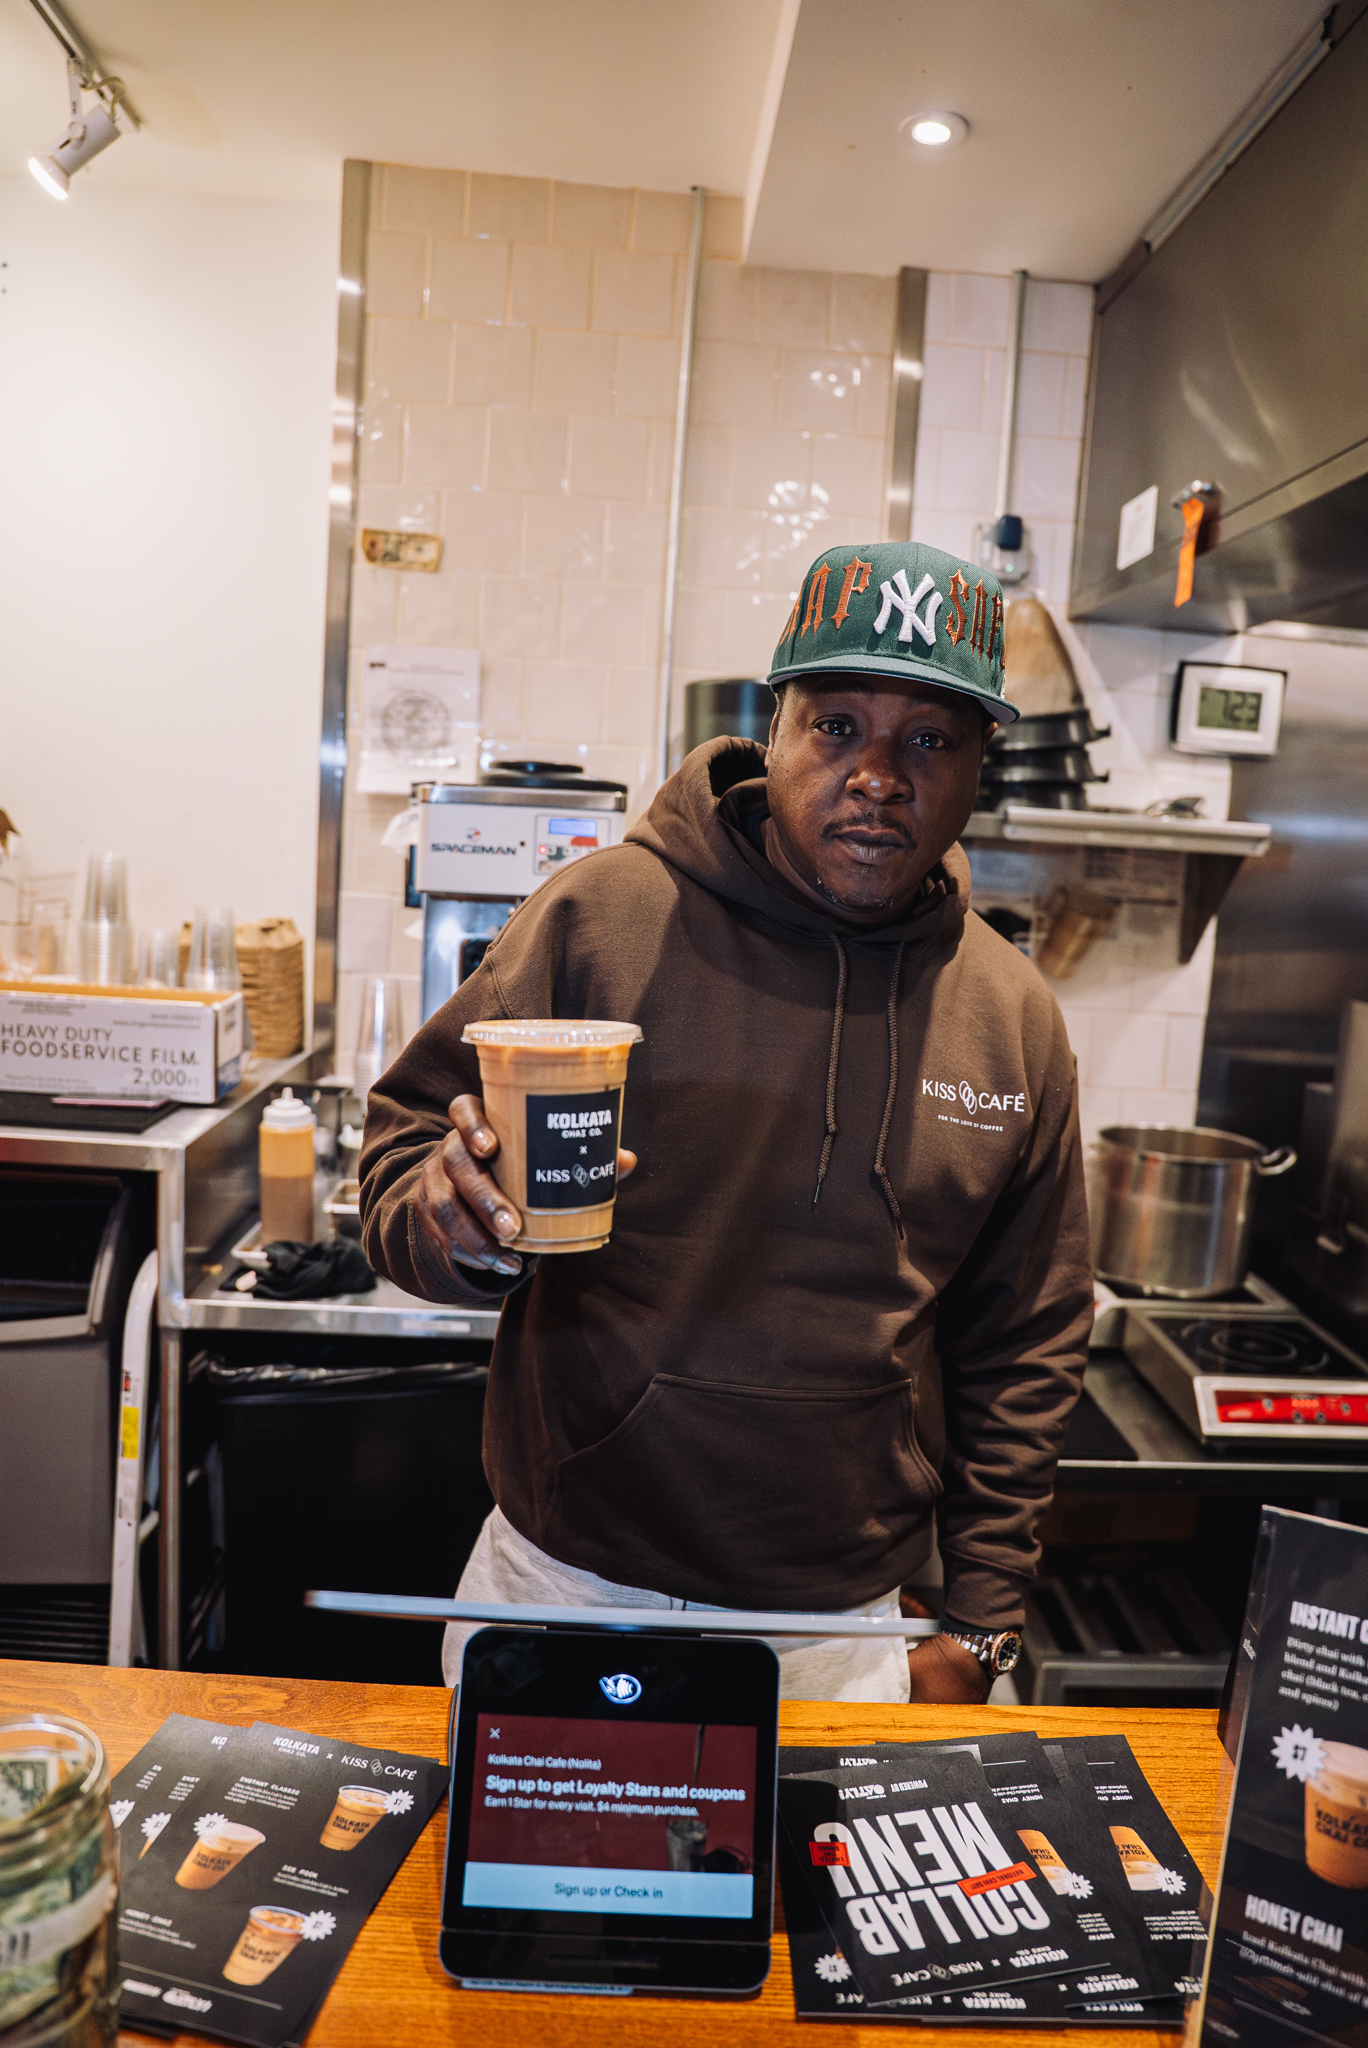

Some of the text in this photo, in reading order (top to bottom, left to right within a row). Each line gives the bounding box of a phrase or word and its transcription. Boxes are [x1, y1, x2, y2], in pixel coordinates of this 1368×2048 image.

[431, 843, 517, 856] SPACEMAN
[1, 1022, 113, 1042] HEAVY DUTY
[1, 1038, 142, 1063] FOODSERVICE
[133, 1065, 187, 1088] 2,000
[922, 1079, 1026, 1112] KISS CAFÉ
[546, 1109, 612, 1129] KOLKATA
[937, 1114, 949, 1122] FOR
[960, 1119, 973, 1127] LOVE
[980, 1124, 1004, 1132] COFFEE
[561, 1129, 587, 1139] CHAI
[535, 1160, 615, 1183] KISS CAFÉ
[1289, 1600, 1361, 1641] INSTANT
[273, 1736, 320, 1756] KOLKATA
[341, 1755, 368, 1769] KISS
[487, 1753, 523, 1767] Kolkata
[523, 1755, 545, 1768] Chai
[545, 1756, 567, 1769] Cafe
[485, 1775, 746, 1803] Sign up to get Loyalty Stars and coupons
[890, 1779, 929, 1793] POWERED BY
[484, 1795, 507, 1808] Earn
[507, 1797, 513, 1808] 1
[513, 1796, 533, 1809] Star
[533, 1798, 548, 1810] for
[548, 1799, 575, 1813] every
[596, 1800, 610, 1813] $4
[610, 1803, 654, 1815] minimum
[813, 1801, 1015, 1899] MENU
[983, 1877, 998, 1887] CHAI
[997, 1869, 1025, 1882] NATIONAL
[554, 1882, 663, 1898] Sign up or Check in
[845, 1880, 1051, 1956] COLLAB
[1244, 1894, 1302, 1935] HONEY
[1301, 1915, 1344, 1953] CHAI
[1009, 1949, 1069, 1968] KOLKATA
[948, 1961, 984, 1976] KISS
[1077, 1977, 1139, 1994] KOLKATA
[962, 1997, 1027, 2010] KOLKATA
